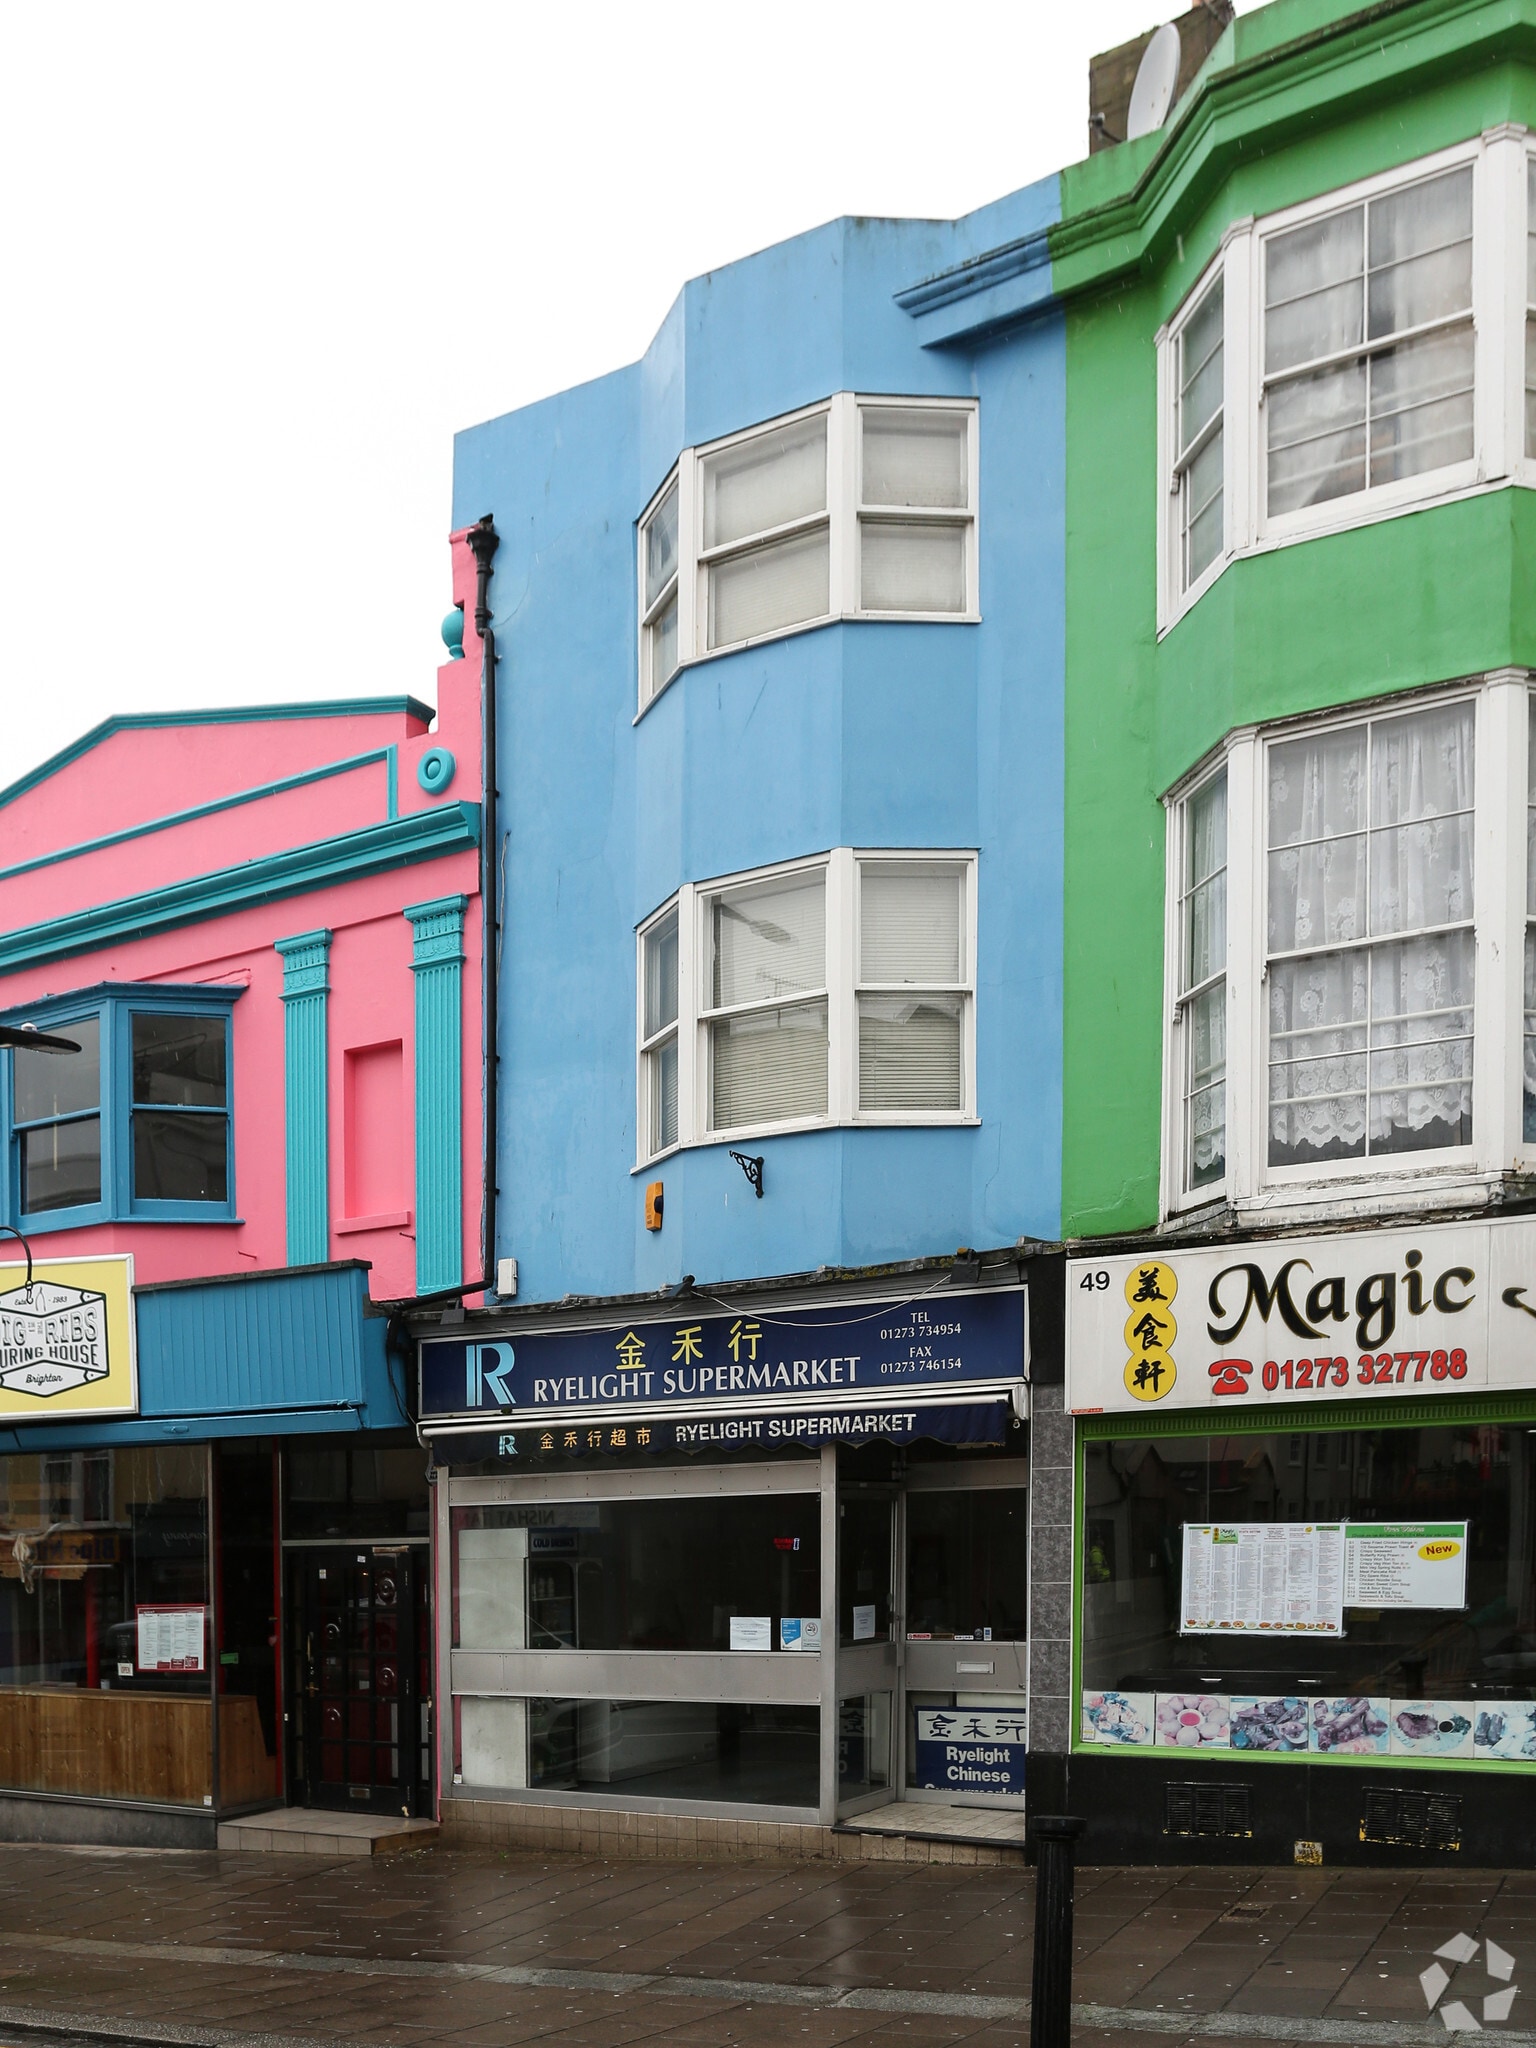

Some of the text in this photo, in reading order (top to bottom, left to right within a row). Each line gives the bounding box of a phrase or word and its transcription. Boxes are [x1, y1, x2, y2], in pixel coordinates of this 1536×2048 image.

[1079, 1271, 1111, 1292] 49
[1207, 1249, 1476, 1351] Magic
[0, 1314, 26, 1346] IG
[45, 1306, 97, 1344] RIBS
[910, 1312, 930, 1324] TEL
[880, 1323, 962, 1340] 01273 734954
[1132, 1267, 1169, 1393] 美食軒
[615, 1319, 763, 1370] 金禾行
[909, 1345, 932, 1358] FAX
[0, 1344, 99, 1369] URING HOUSE
[880, 1357, 962, 1374] 01273 746154
[25, 1373, 63, 1386] Brighton
[466, 1342, 517, 1407] R
[534, 1357, 861, 1403] RYELIGHT SUPERMARKET
[1261, 1348, 1468, 1391] 01273 327788
[540, 1427, 651, 1449] 金禾行超市
[676, 1413, 917, 1443] RYELIGHT SUPERMARKET
[498, 1434, 519, 1455] R
[1425, 1543, 1453, 1556] New
[946, 1746, 1011, 1765] Ryelight
[946, 1765, 1011, 1783] Chinese
